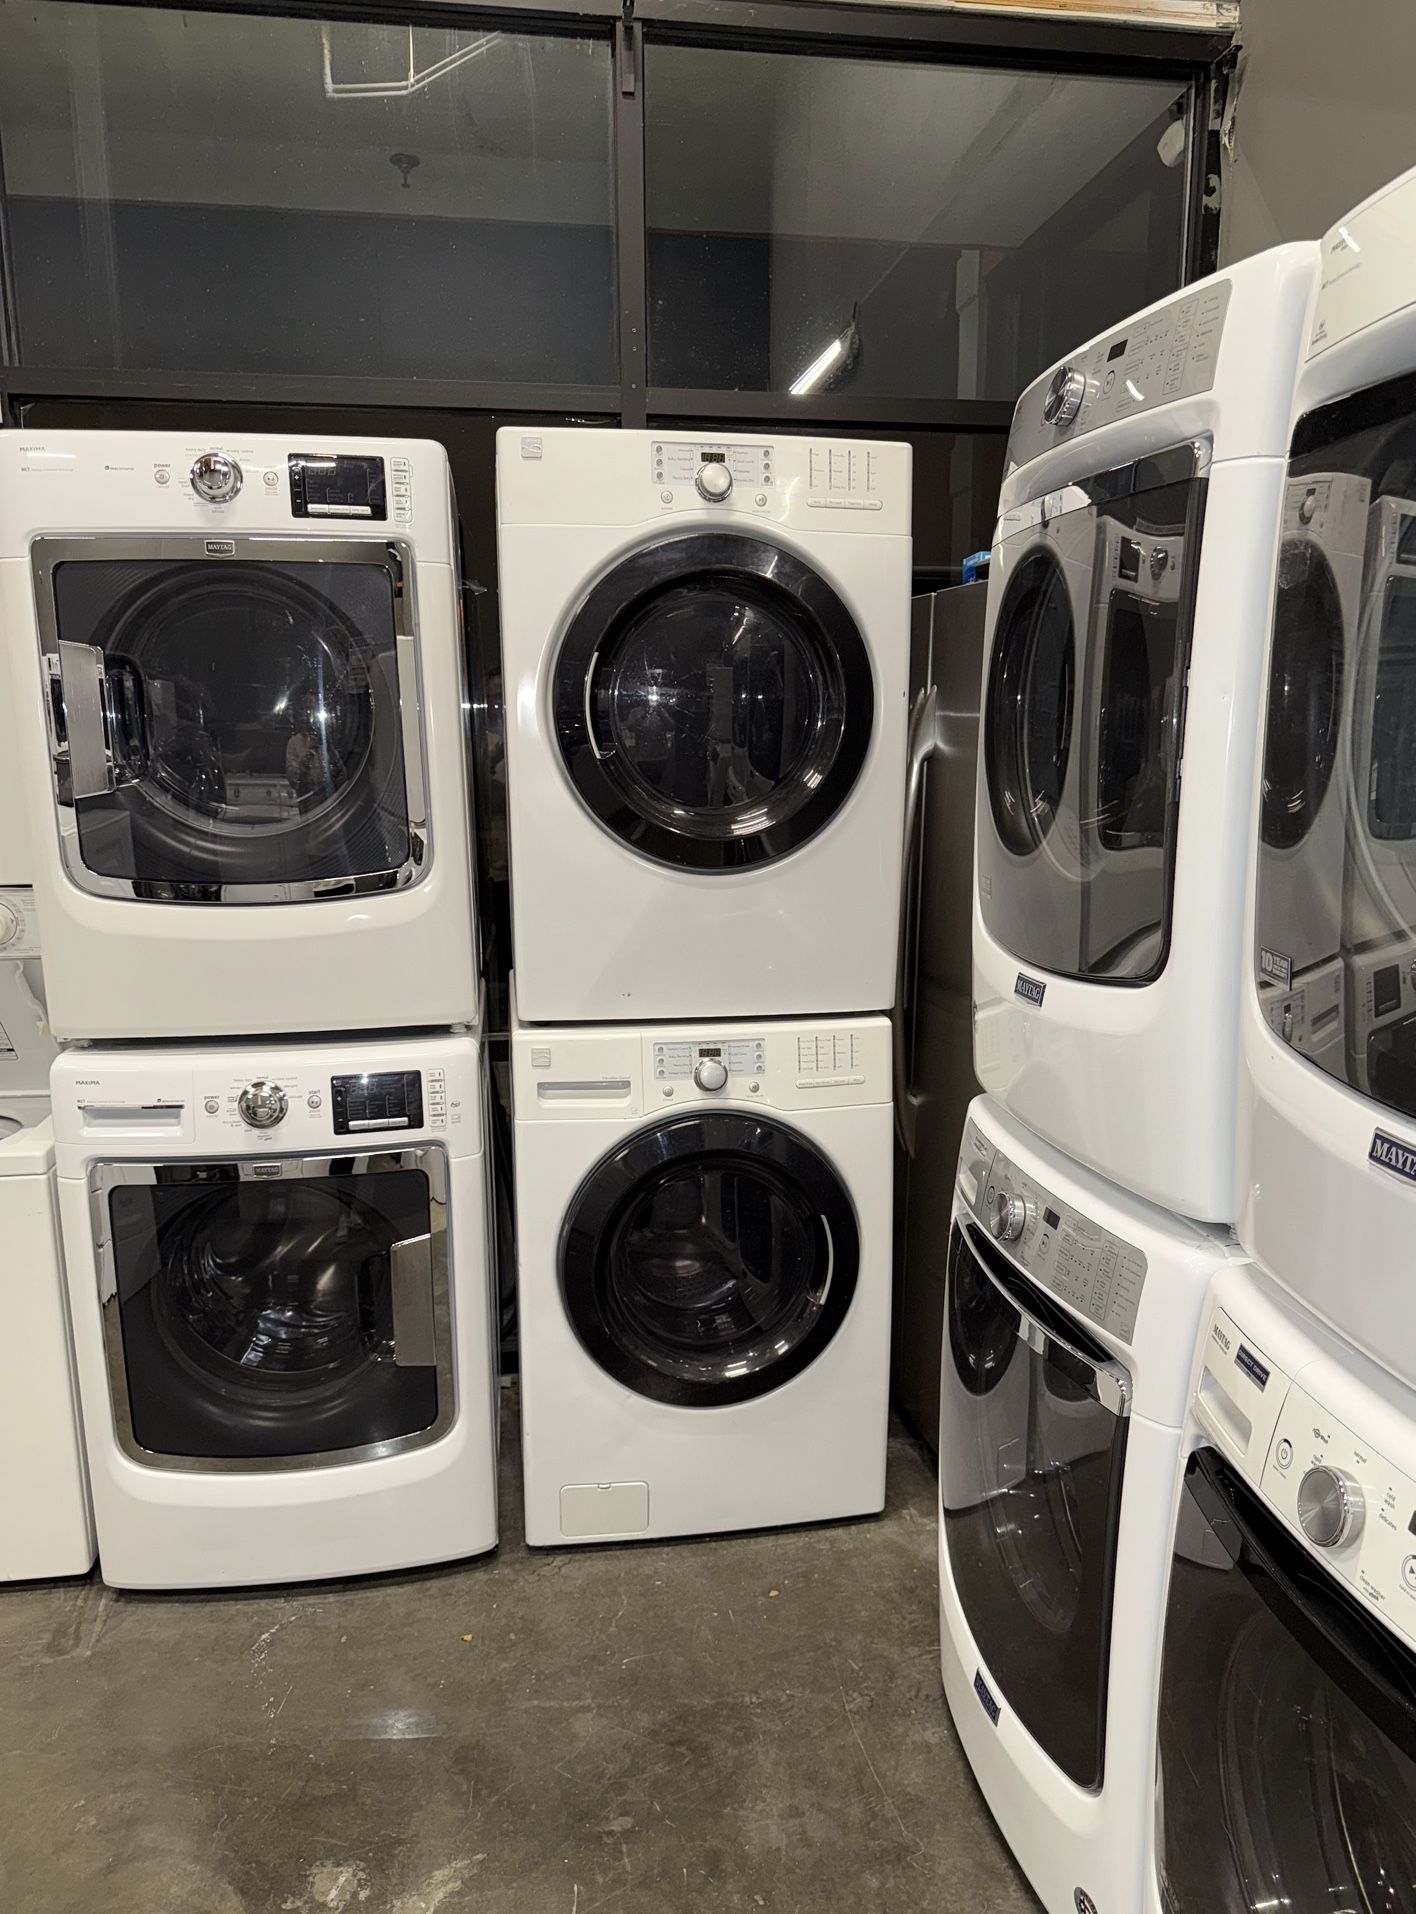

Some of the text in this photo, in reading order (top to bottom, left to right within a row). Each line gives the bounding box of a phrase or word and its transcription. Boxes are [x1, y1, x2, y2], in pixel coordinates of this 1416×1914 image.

[1261, 950, 1288, 972] 10 YEAR
[1016, 979, 1041, 1000] MAYTAG
[1213, 1323, 1231, 1351] MAYTAG
[1238, 1349, 1268, 1383] DIRECT DRIVE
